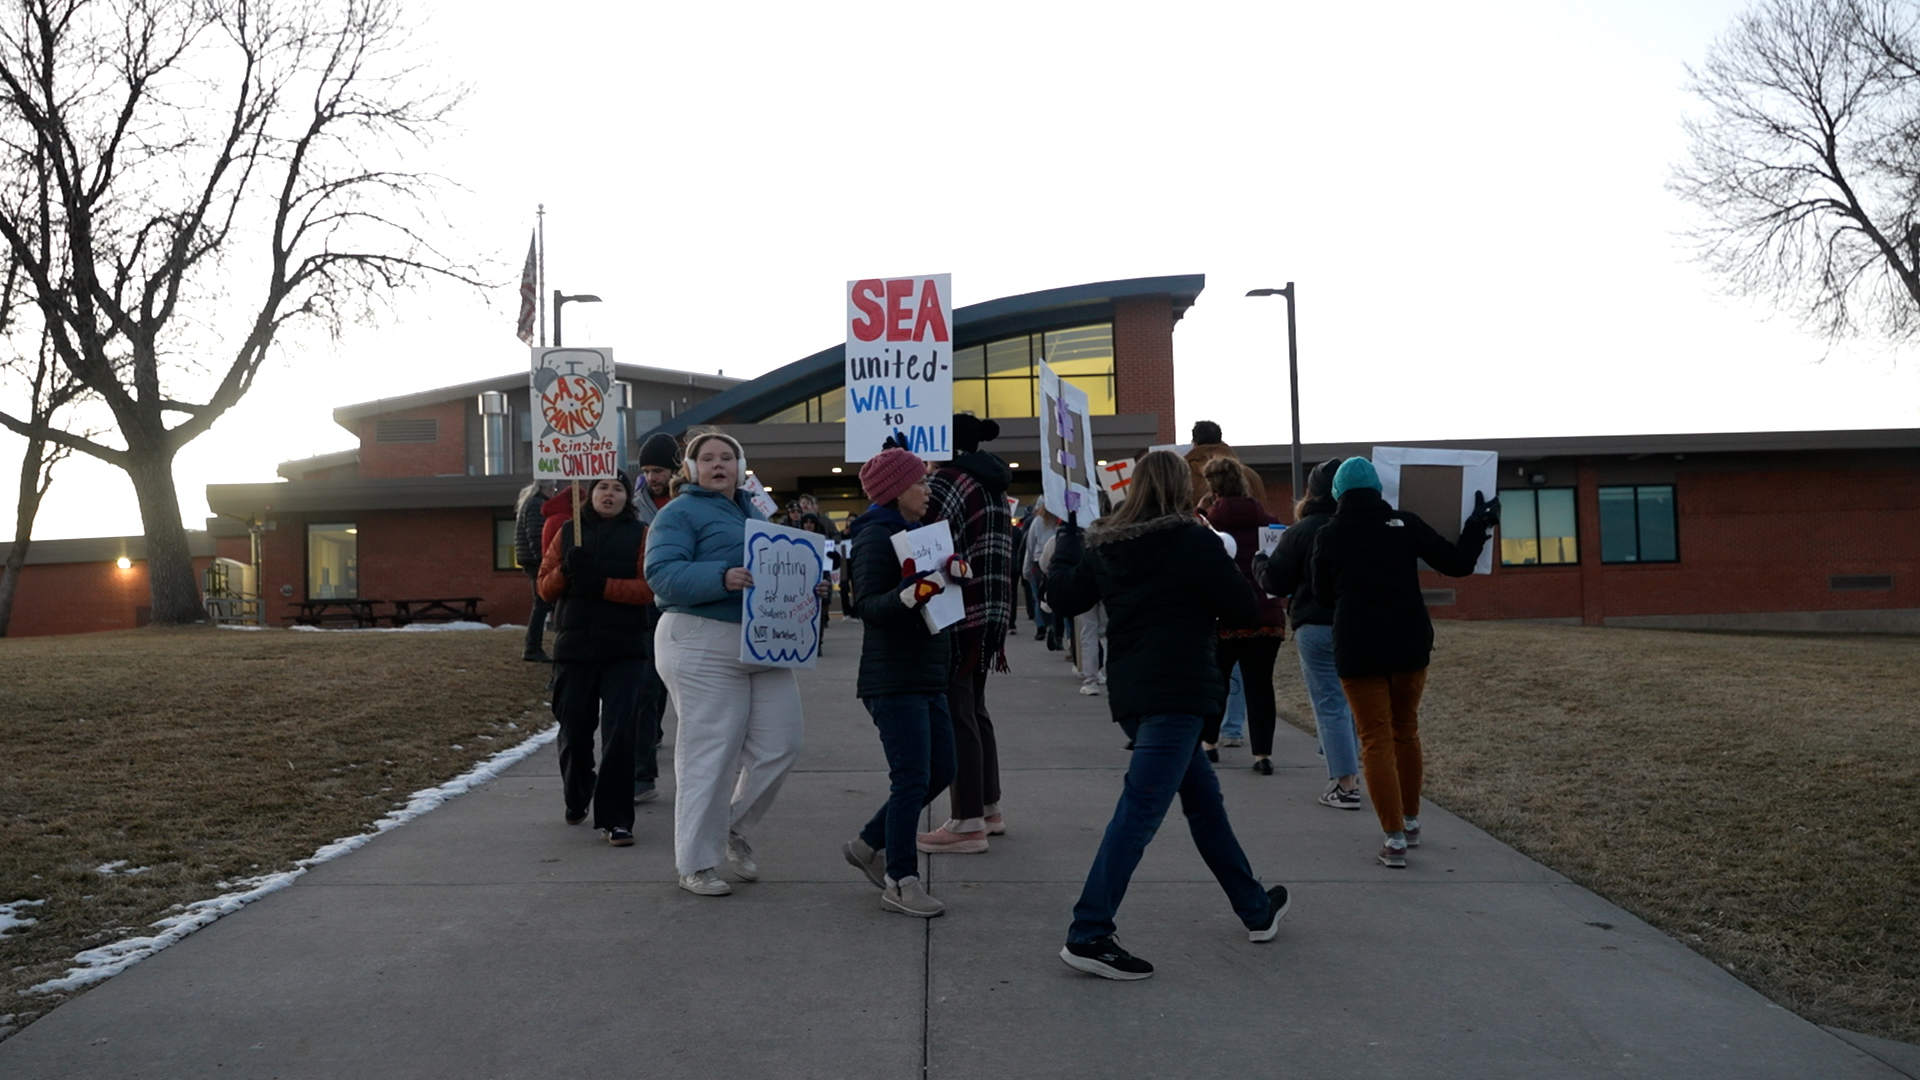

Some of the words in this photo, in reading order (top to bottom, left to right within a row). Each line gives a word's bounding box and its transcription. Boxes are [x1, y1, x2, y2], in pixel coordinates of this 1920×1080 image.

[852, 279, 949, 342] SEA
[541, 377, 602, 406] LAST
[850, 385, 919, 414] WALL
[543, 401, 601, 435] CHANCE
[883, 412, 904, 426] to
[538, 440, 550, 453] to
[552, 437, 613, 454] Reinstate
[561, 451, 617, 477] CONTRACT
[935, 539, 943, 552] to
[758, 547, 807, 596] Fighting
[764, 590, 778, 604] for
[783, 594, 798, 604] our
[753, 625, 769, 640] NOT
